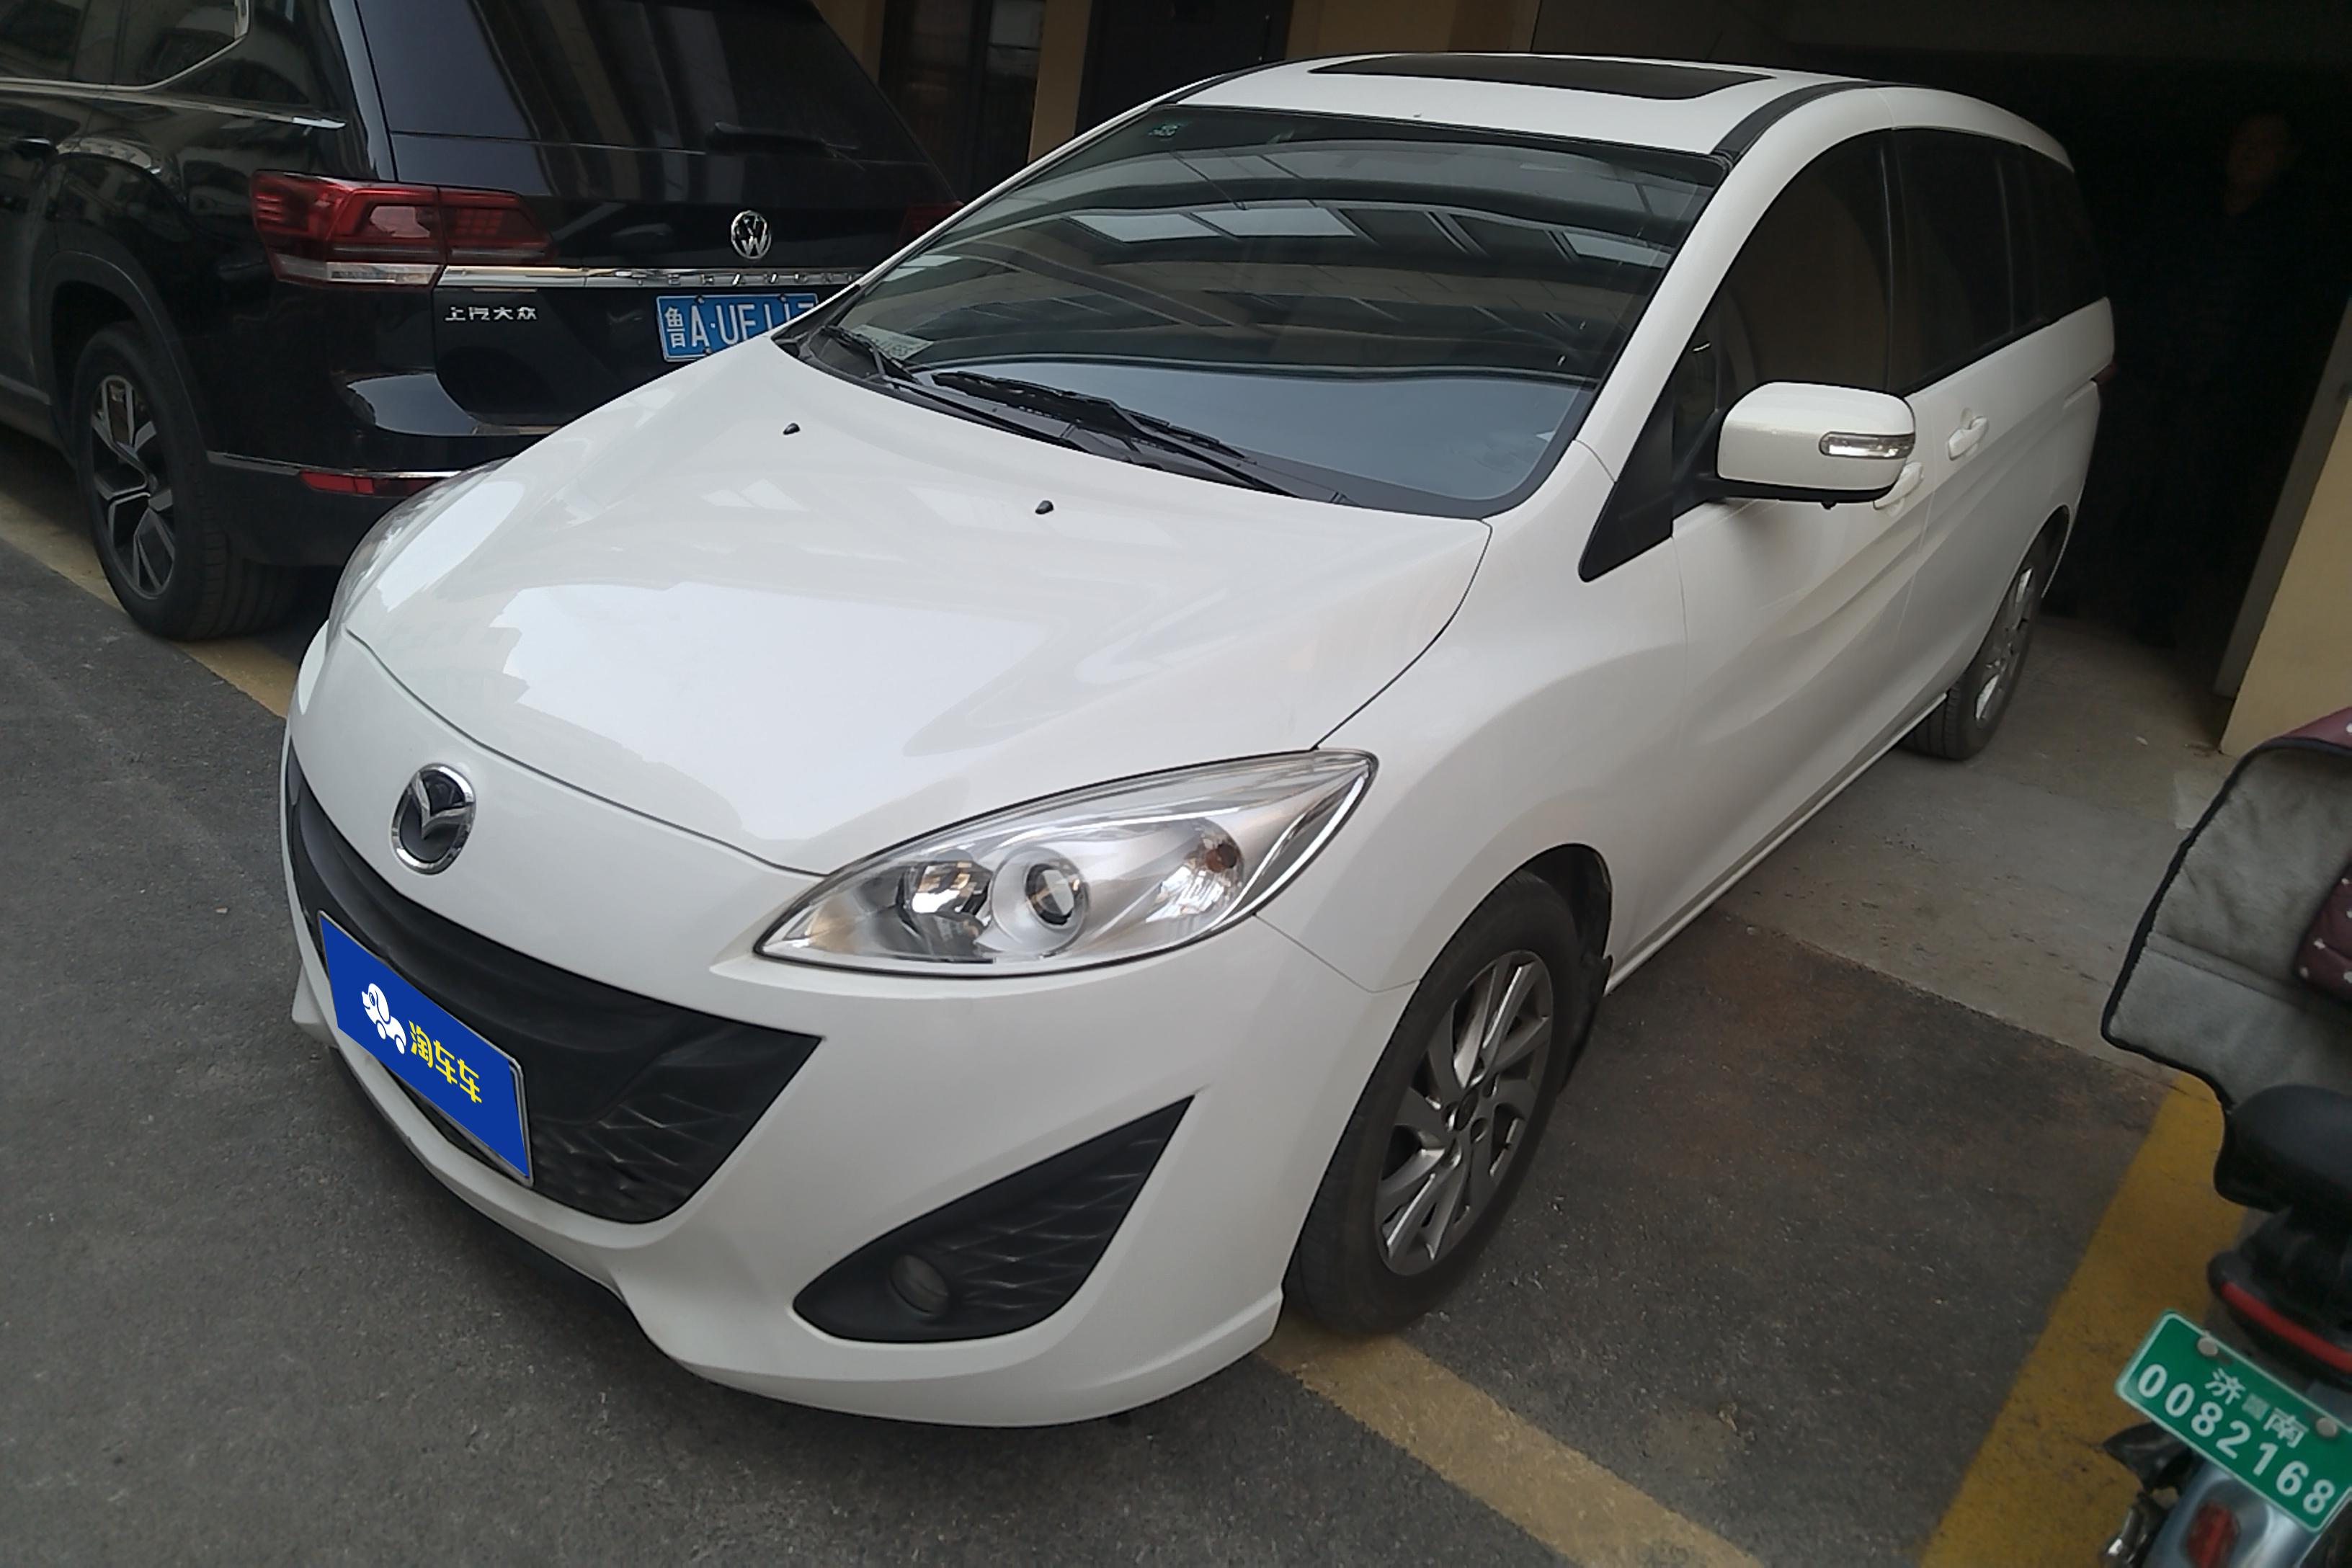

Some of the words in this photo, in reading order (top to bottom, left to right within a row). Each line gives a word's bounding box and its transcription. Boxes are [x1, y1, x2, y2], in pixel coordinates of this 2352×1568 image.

[444, 306, 538, 321] 上汽大众
[2137, 1363, 2335, 1515] 0082168
